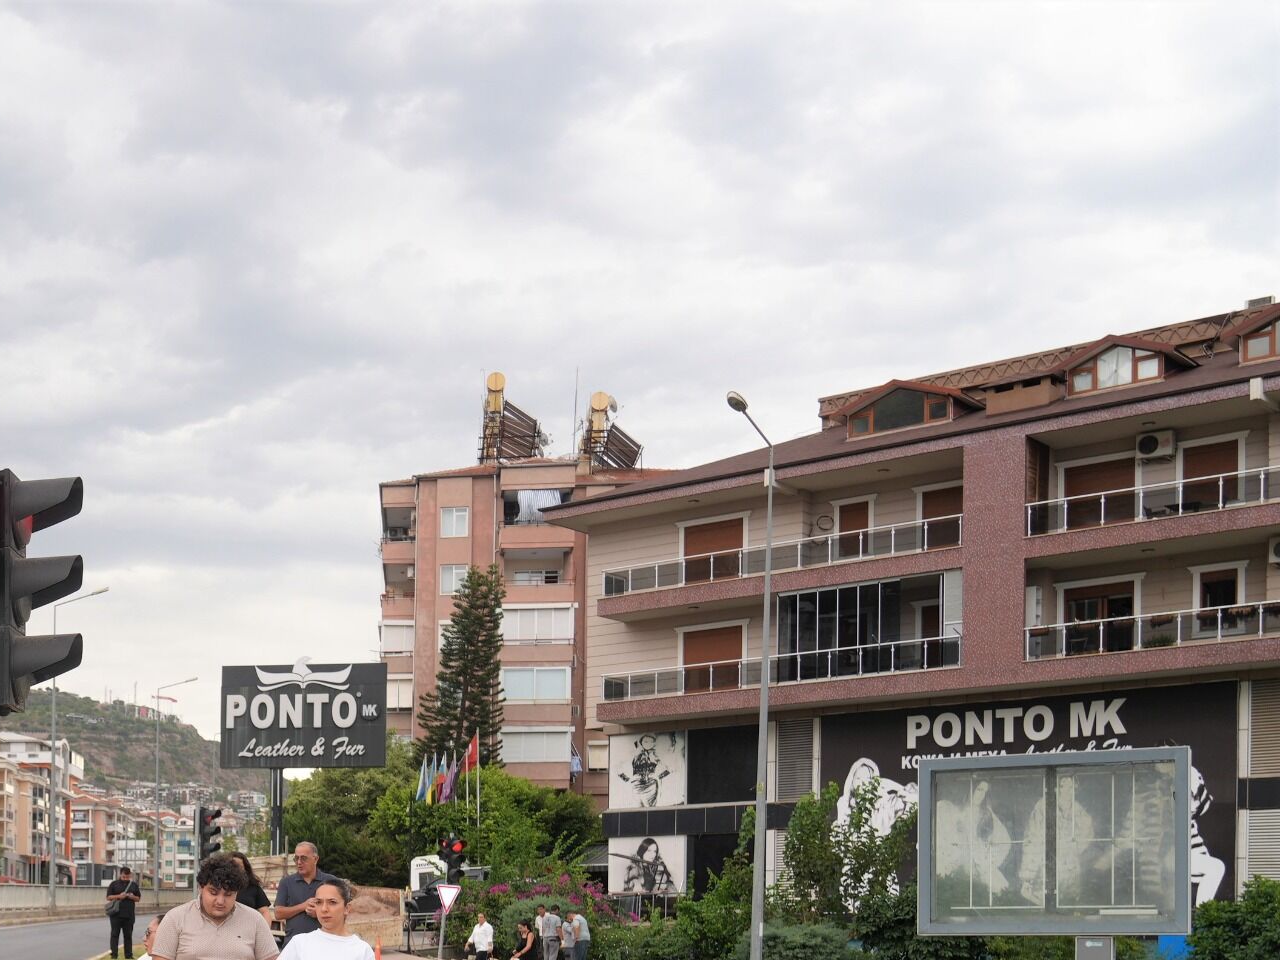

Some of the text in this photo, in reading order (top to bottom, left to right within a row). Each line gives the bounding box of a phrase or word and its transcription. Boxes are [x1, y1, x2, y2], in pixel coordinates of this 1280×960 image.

[225, 692, 377, 730] PONTO MK
[906, 698, 1127, 749] PONTO MK
[238, 736, 365, 759] Leather & Fur
